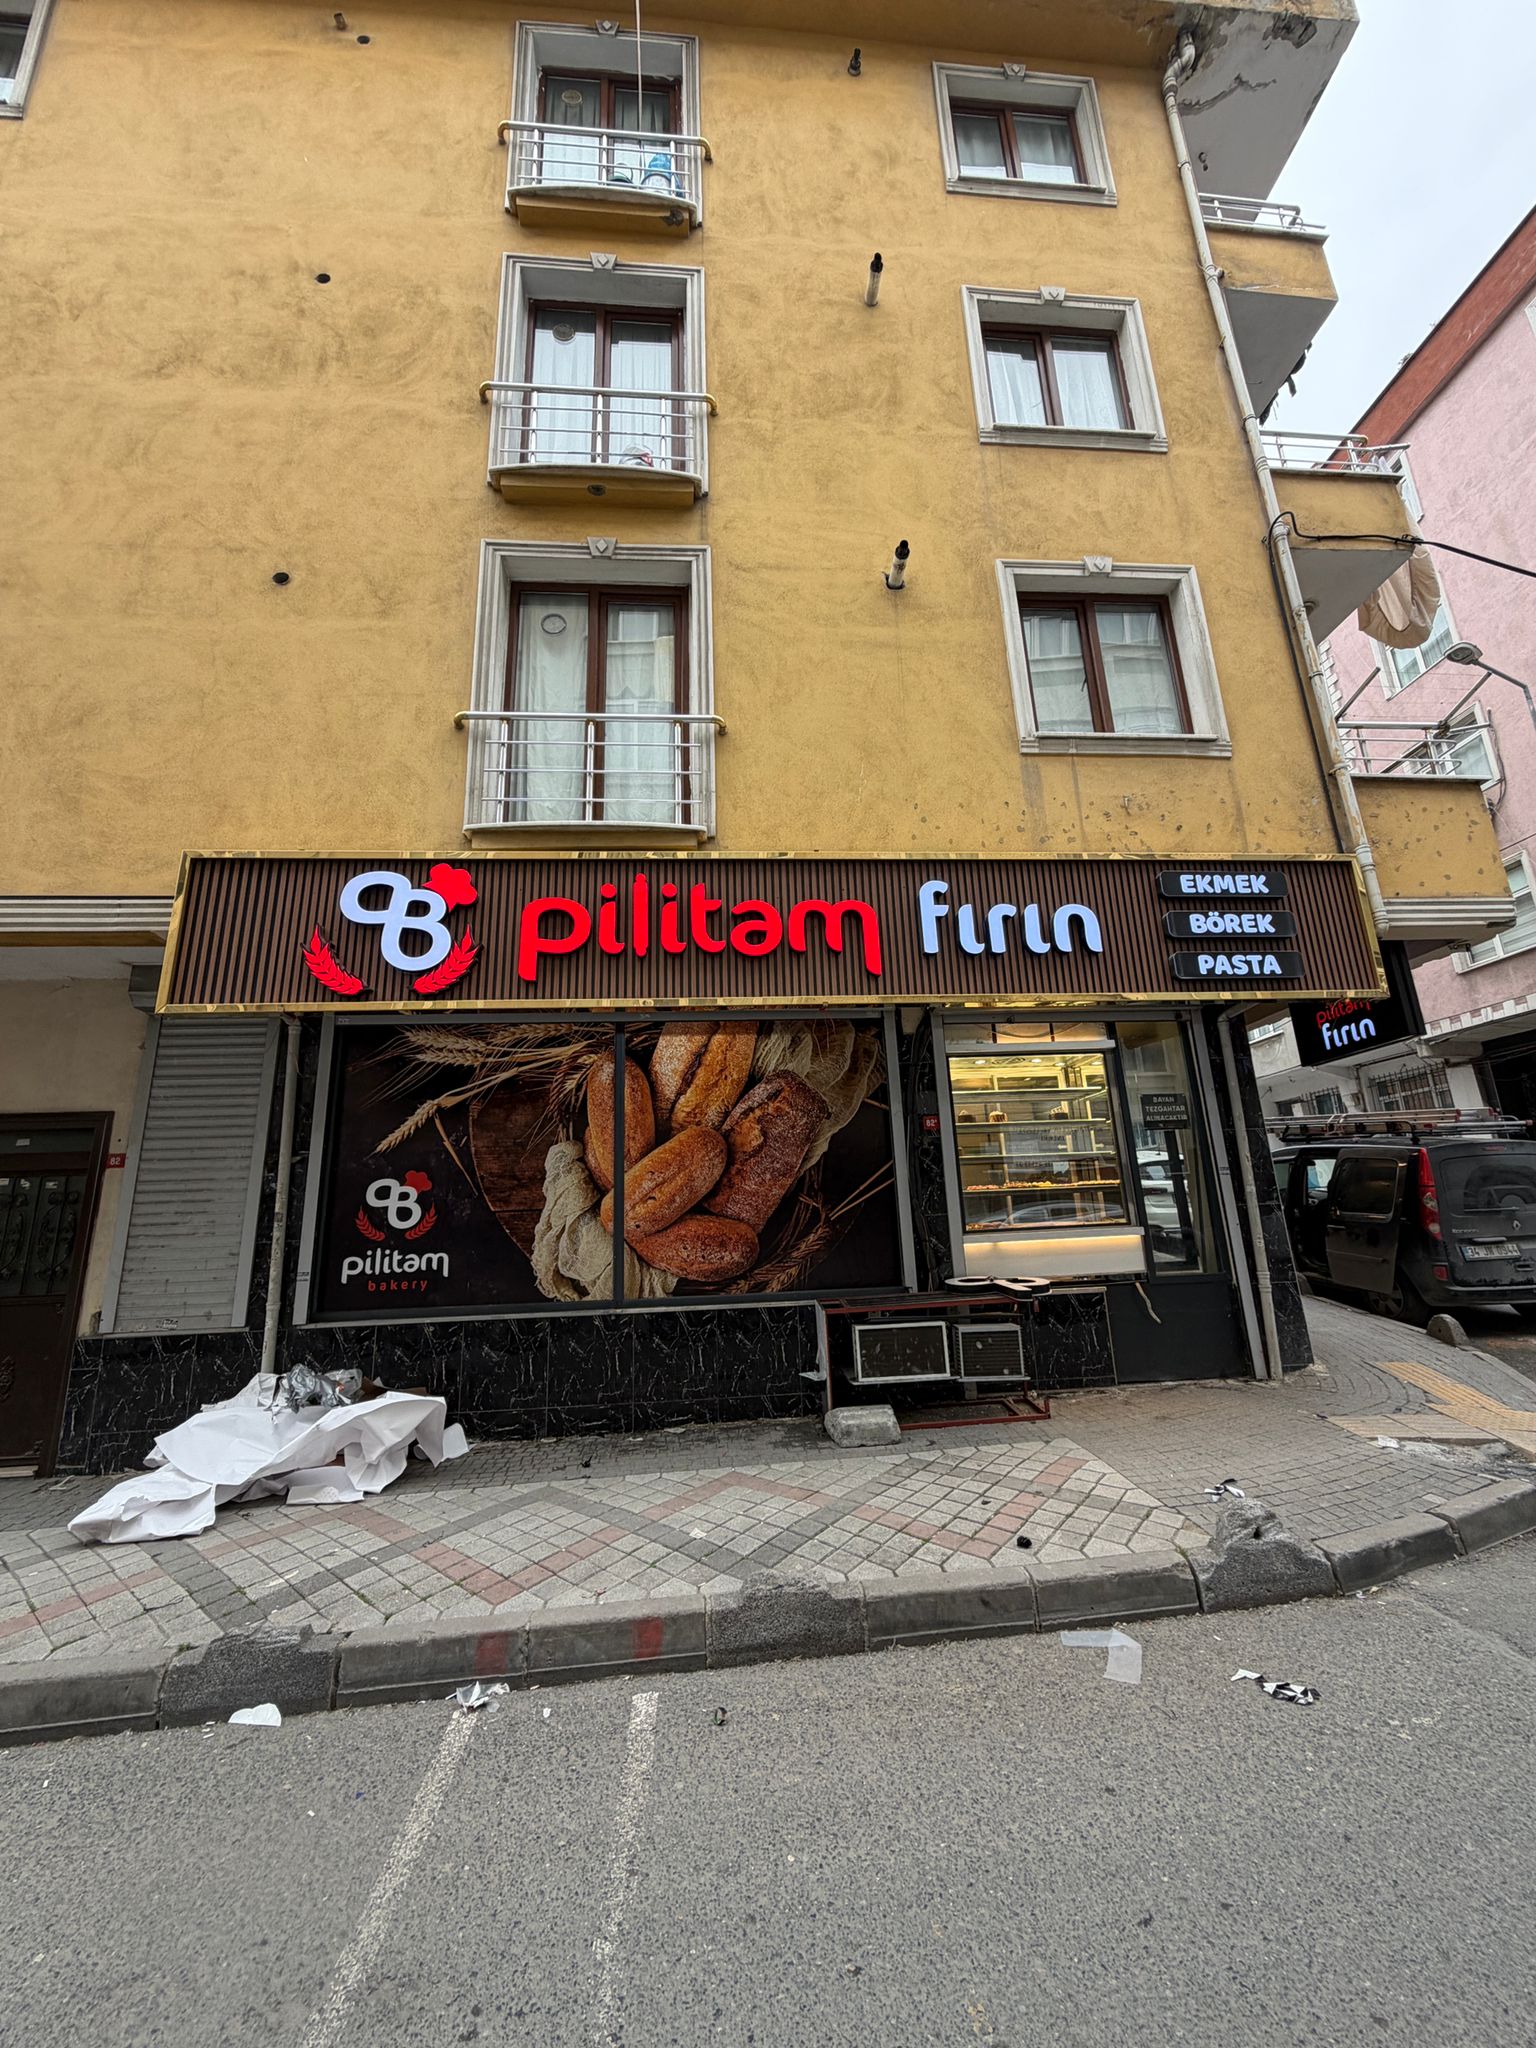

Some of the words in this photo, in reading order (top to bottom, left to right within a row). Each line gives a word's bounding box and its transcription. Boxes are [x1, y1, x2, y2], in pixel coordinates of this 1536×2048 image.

[1179, 874, 1270, 894] EKMEK
[518, 874, 882, 981] pilitam
[919, 880, 1103, 955] fırın
[1189, 911, 1276, 934] BÖREK
[1197, 954, 1282, 975] PASTA
[340, 1248, 449, 1284] pilitam
[368, 1280, 427, 1292] bakery
